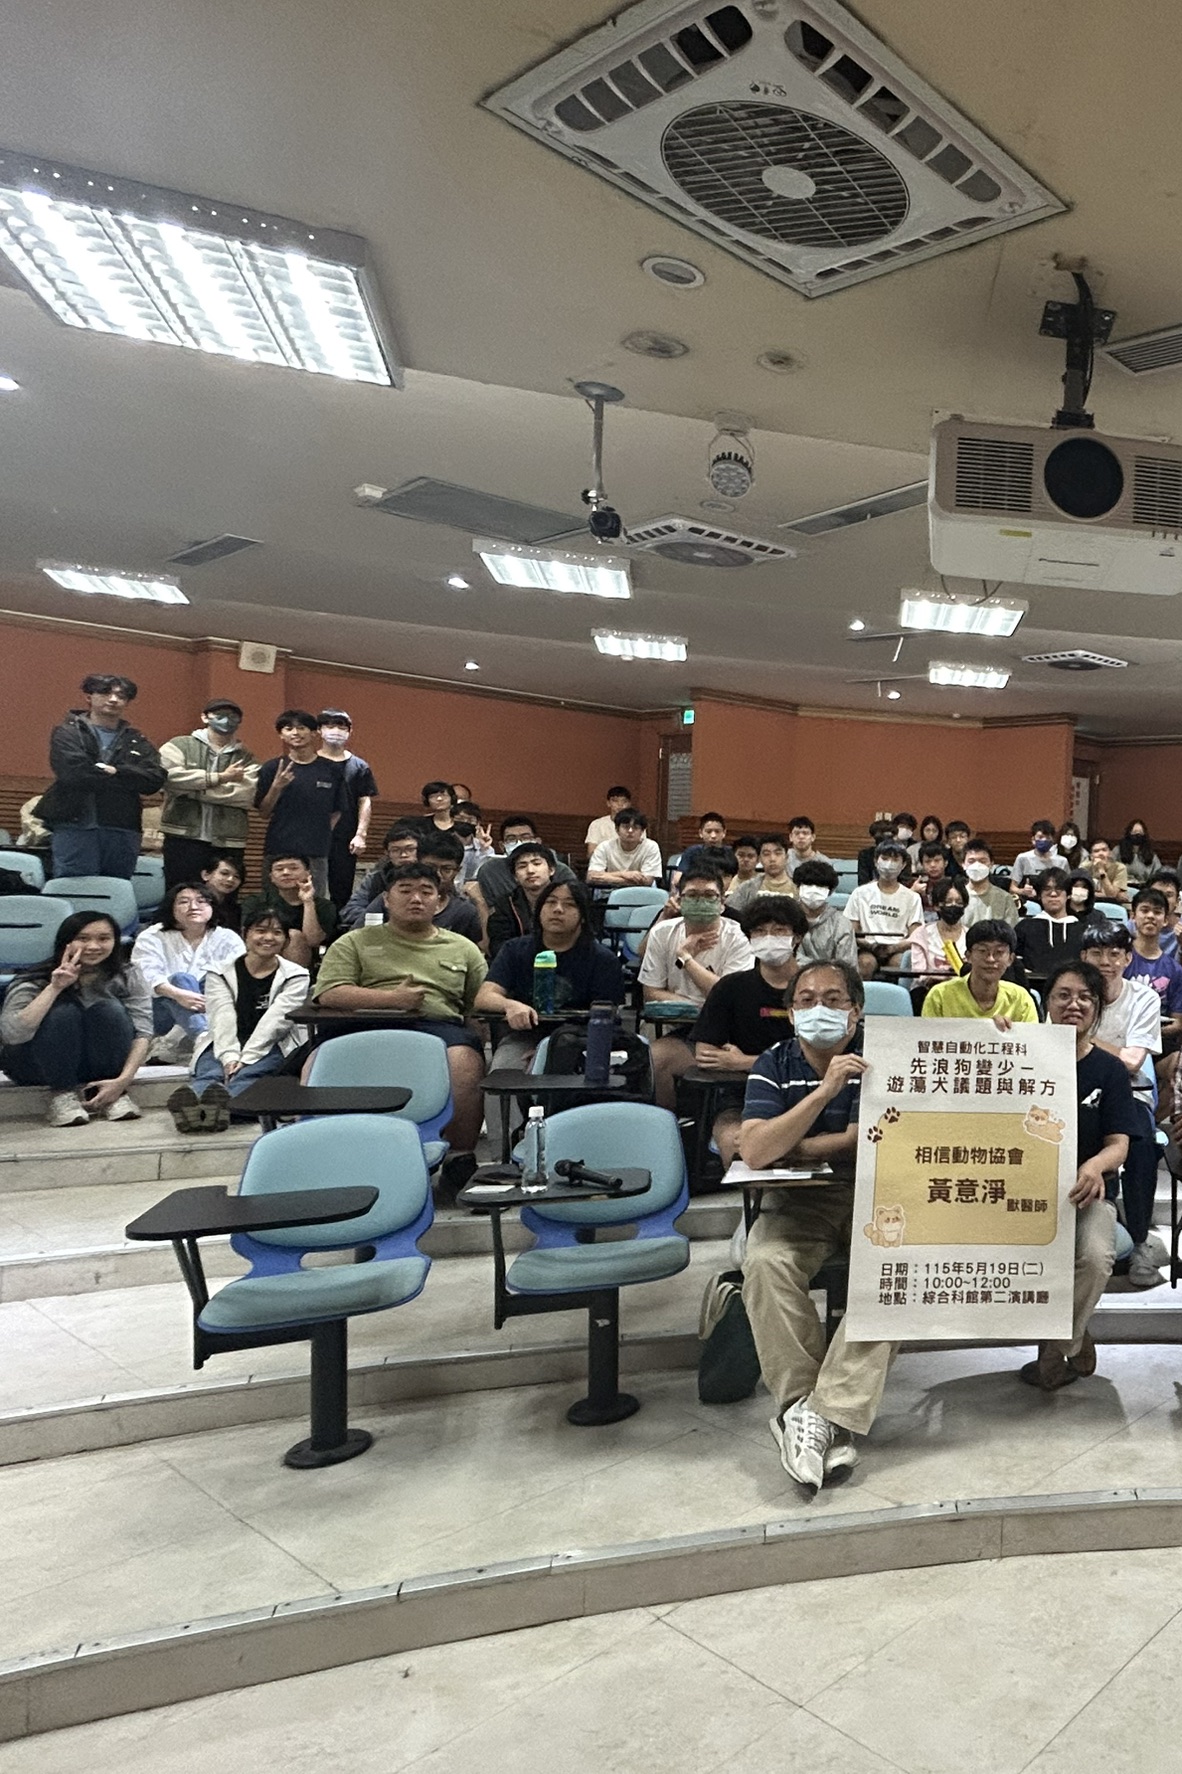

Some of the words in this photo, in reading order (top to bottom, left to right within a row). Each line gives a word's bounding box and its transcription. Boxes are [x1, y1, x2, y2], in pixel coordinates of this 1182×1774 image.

[917, 1041, 1027, 1056] 智慧自動化工程科
[886, 1075, 1056, 1096] 遊蕩犬議題與解方
[915, 1146, 1024, 1165] 相信動物協會
[927, 1178, 1006, 1204] 黃意淨
[1006, 1198, 1048, 1213] 獸醫師
